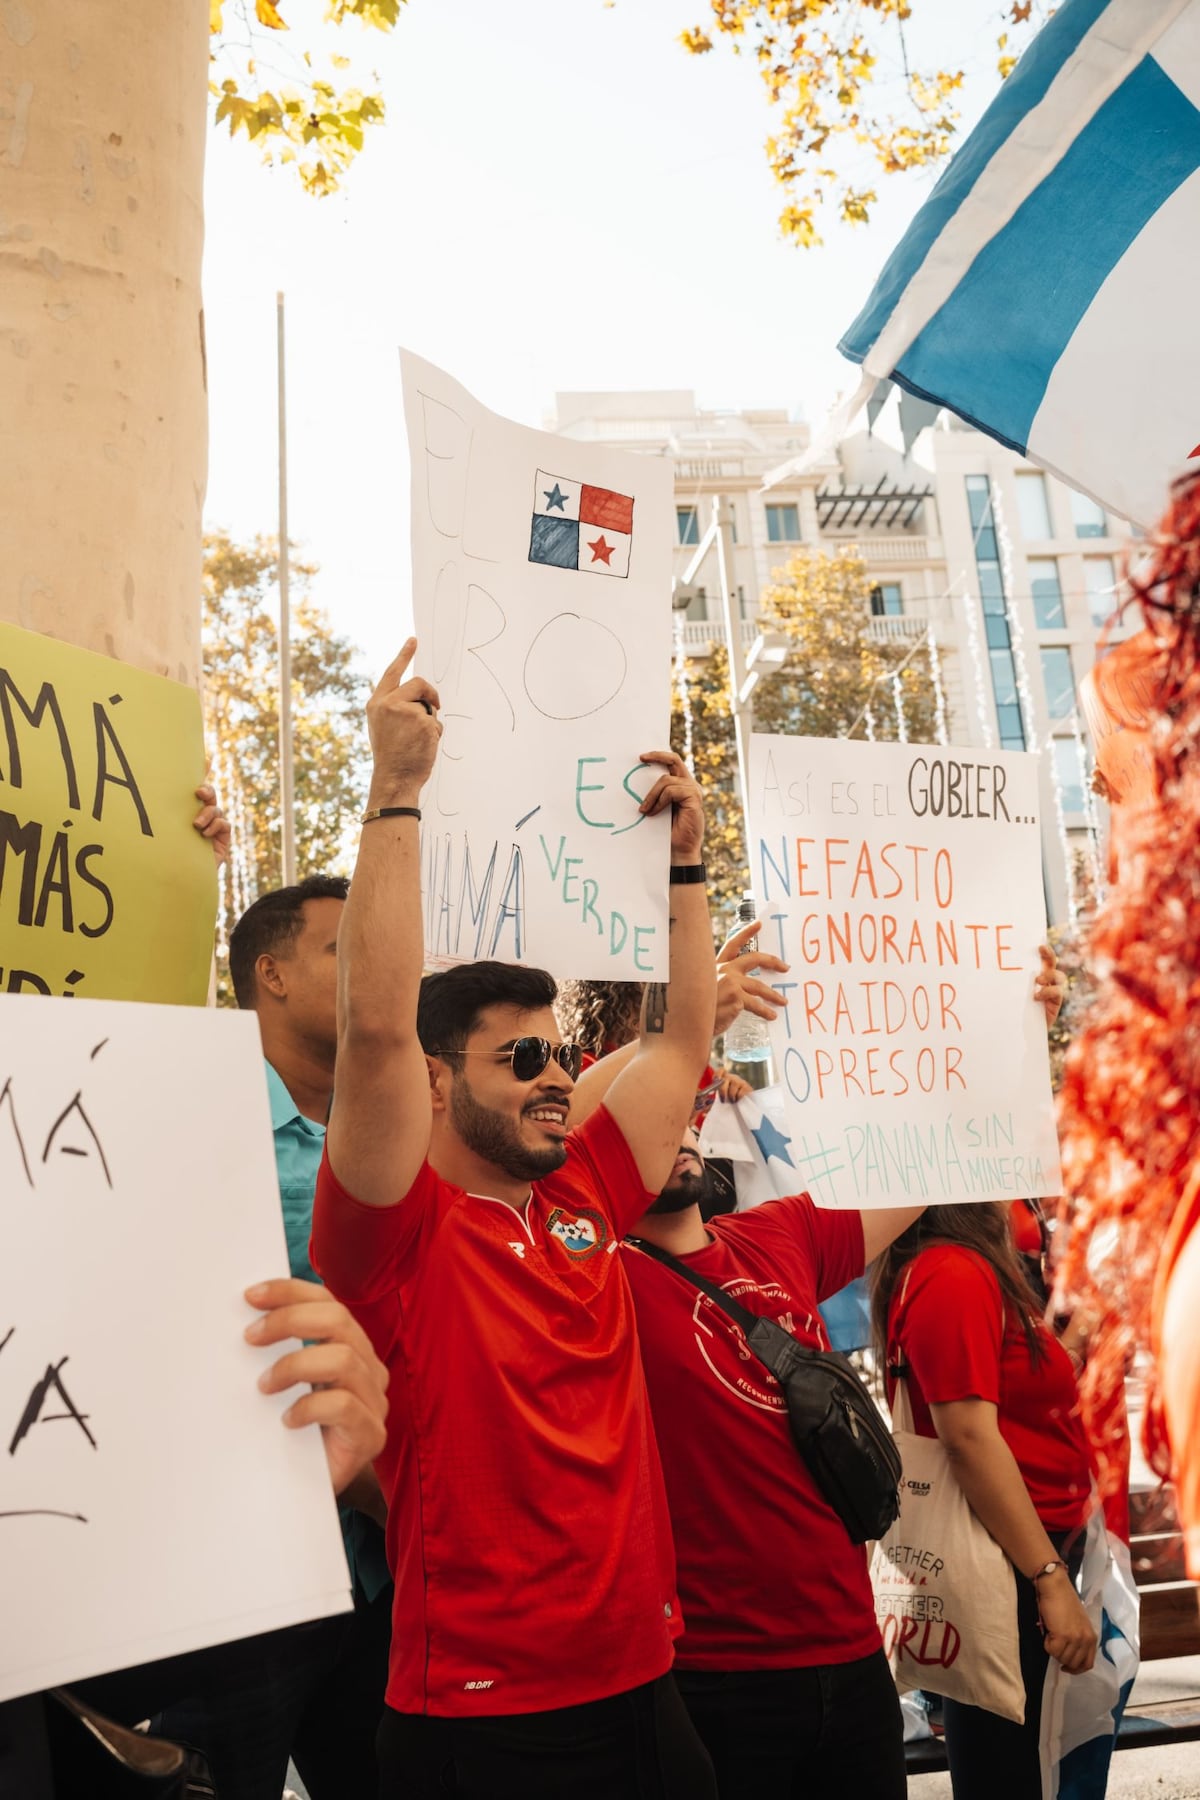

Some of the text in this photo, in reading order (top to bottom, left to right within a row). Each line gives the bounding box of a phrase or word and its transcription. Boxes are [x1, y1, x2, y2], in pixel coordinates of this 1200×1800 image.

[431, 560, 628, 733] ORO
[0, 667, 154, 838] MÁ
[575, 756, 653, 836] ES
[831, 781, 859, 816] ES
[872, 782, 897, 817] EL
[0, 809, 114, 938] MÁS
[538, 834, 657, 972] VERDE
[759, 835, 954, 909] NEFASTO
[769, 910, 1024, 972] IGNORANTE
[771, 980, 964, 1039] TRAIDOR
[783, 1046, 968, 1104] OPRESOR
[798, 1111, 1016, 1206] #PANAMÁ SIN
[873, 1593, 944, 1624] ETTER
[881, 1612, 961, 1670] ORLD
